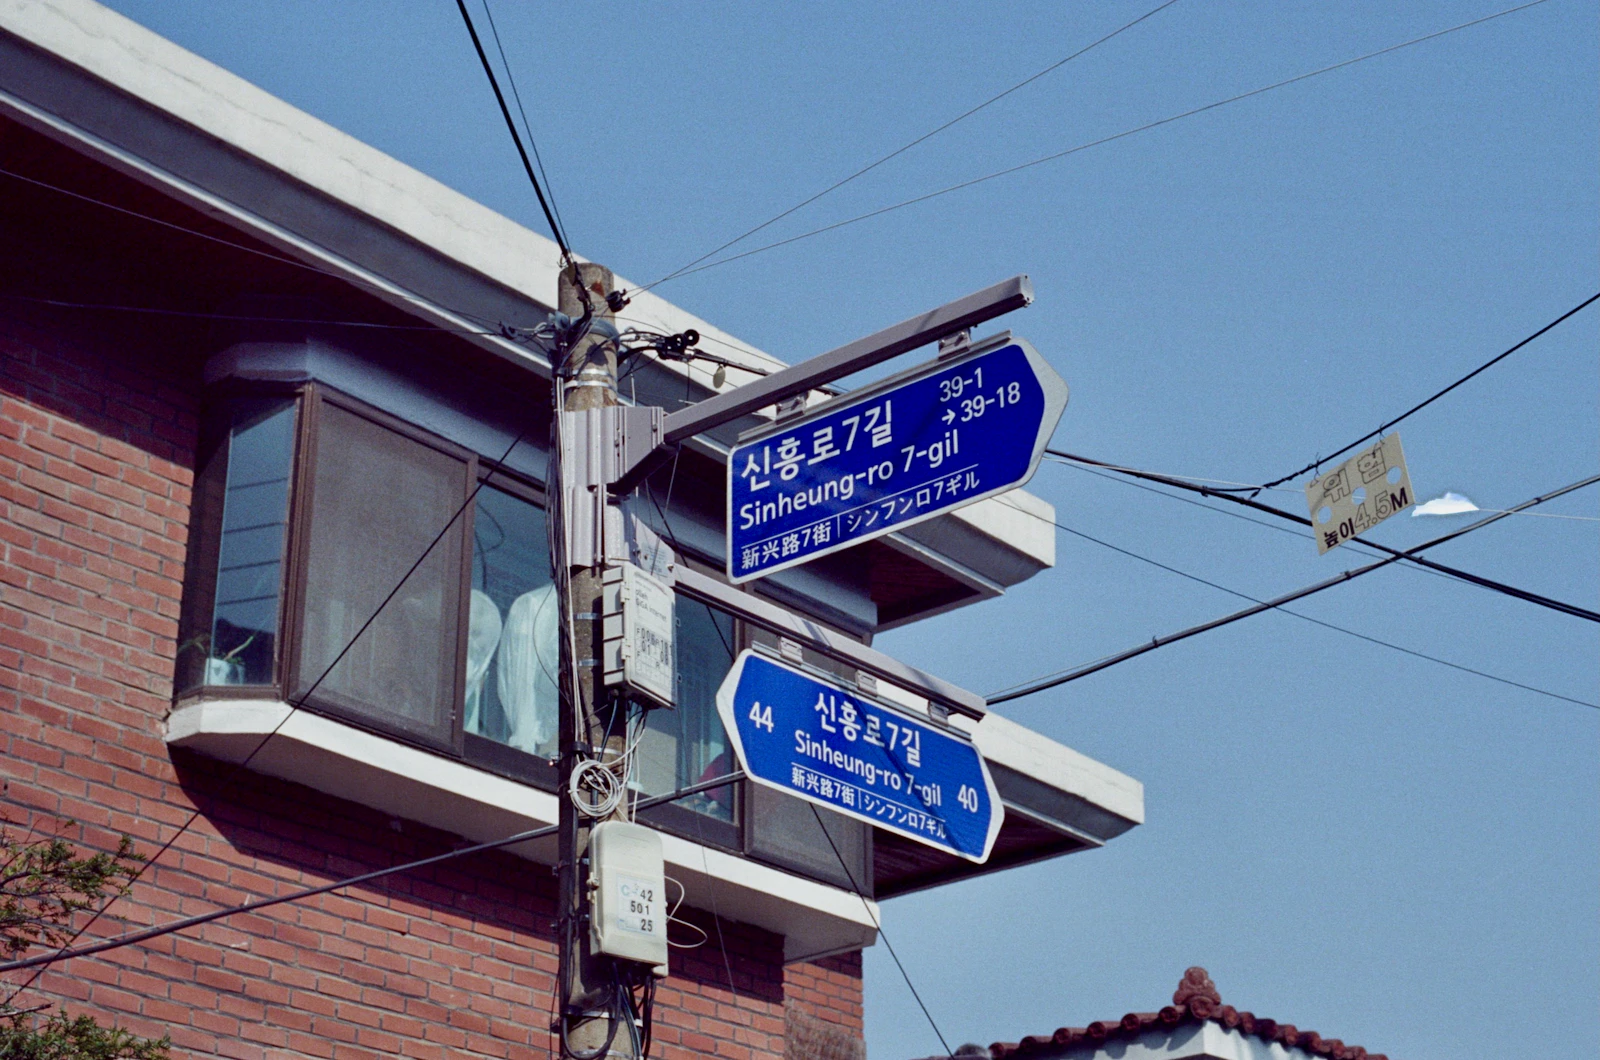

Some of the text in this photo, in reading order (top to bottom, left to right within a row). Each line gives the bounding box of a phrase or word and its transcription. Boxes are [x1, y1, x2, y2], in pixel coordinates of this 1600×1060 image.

[939, 367, 984, 403] 39-1
[960, 381, 1021, 424] 39-18
[740, 400, 893, 492] 신흥로7길
[740, 428, 959, 530] Sinheung-ro 7-gil
[741, 520, 832, 570] 新兴路7街
[748, 701, 775, 733] 44
[814, 692, 921, 769] 신흥로7길
[791, 766, 855, 807] 新兴路7街
[795, 730, 942, 807] Sinheung-ro 7-gil
[957, 784, 979, 813] 40
[630, 900, 650, 915] 501
[640, 889, 653, 903] 42
[640, 919, 653, 932] 25
